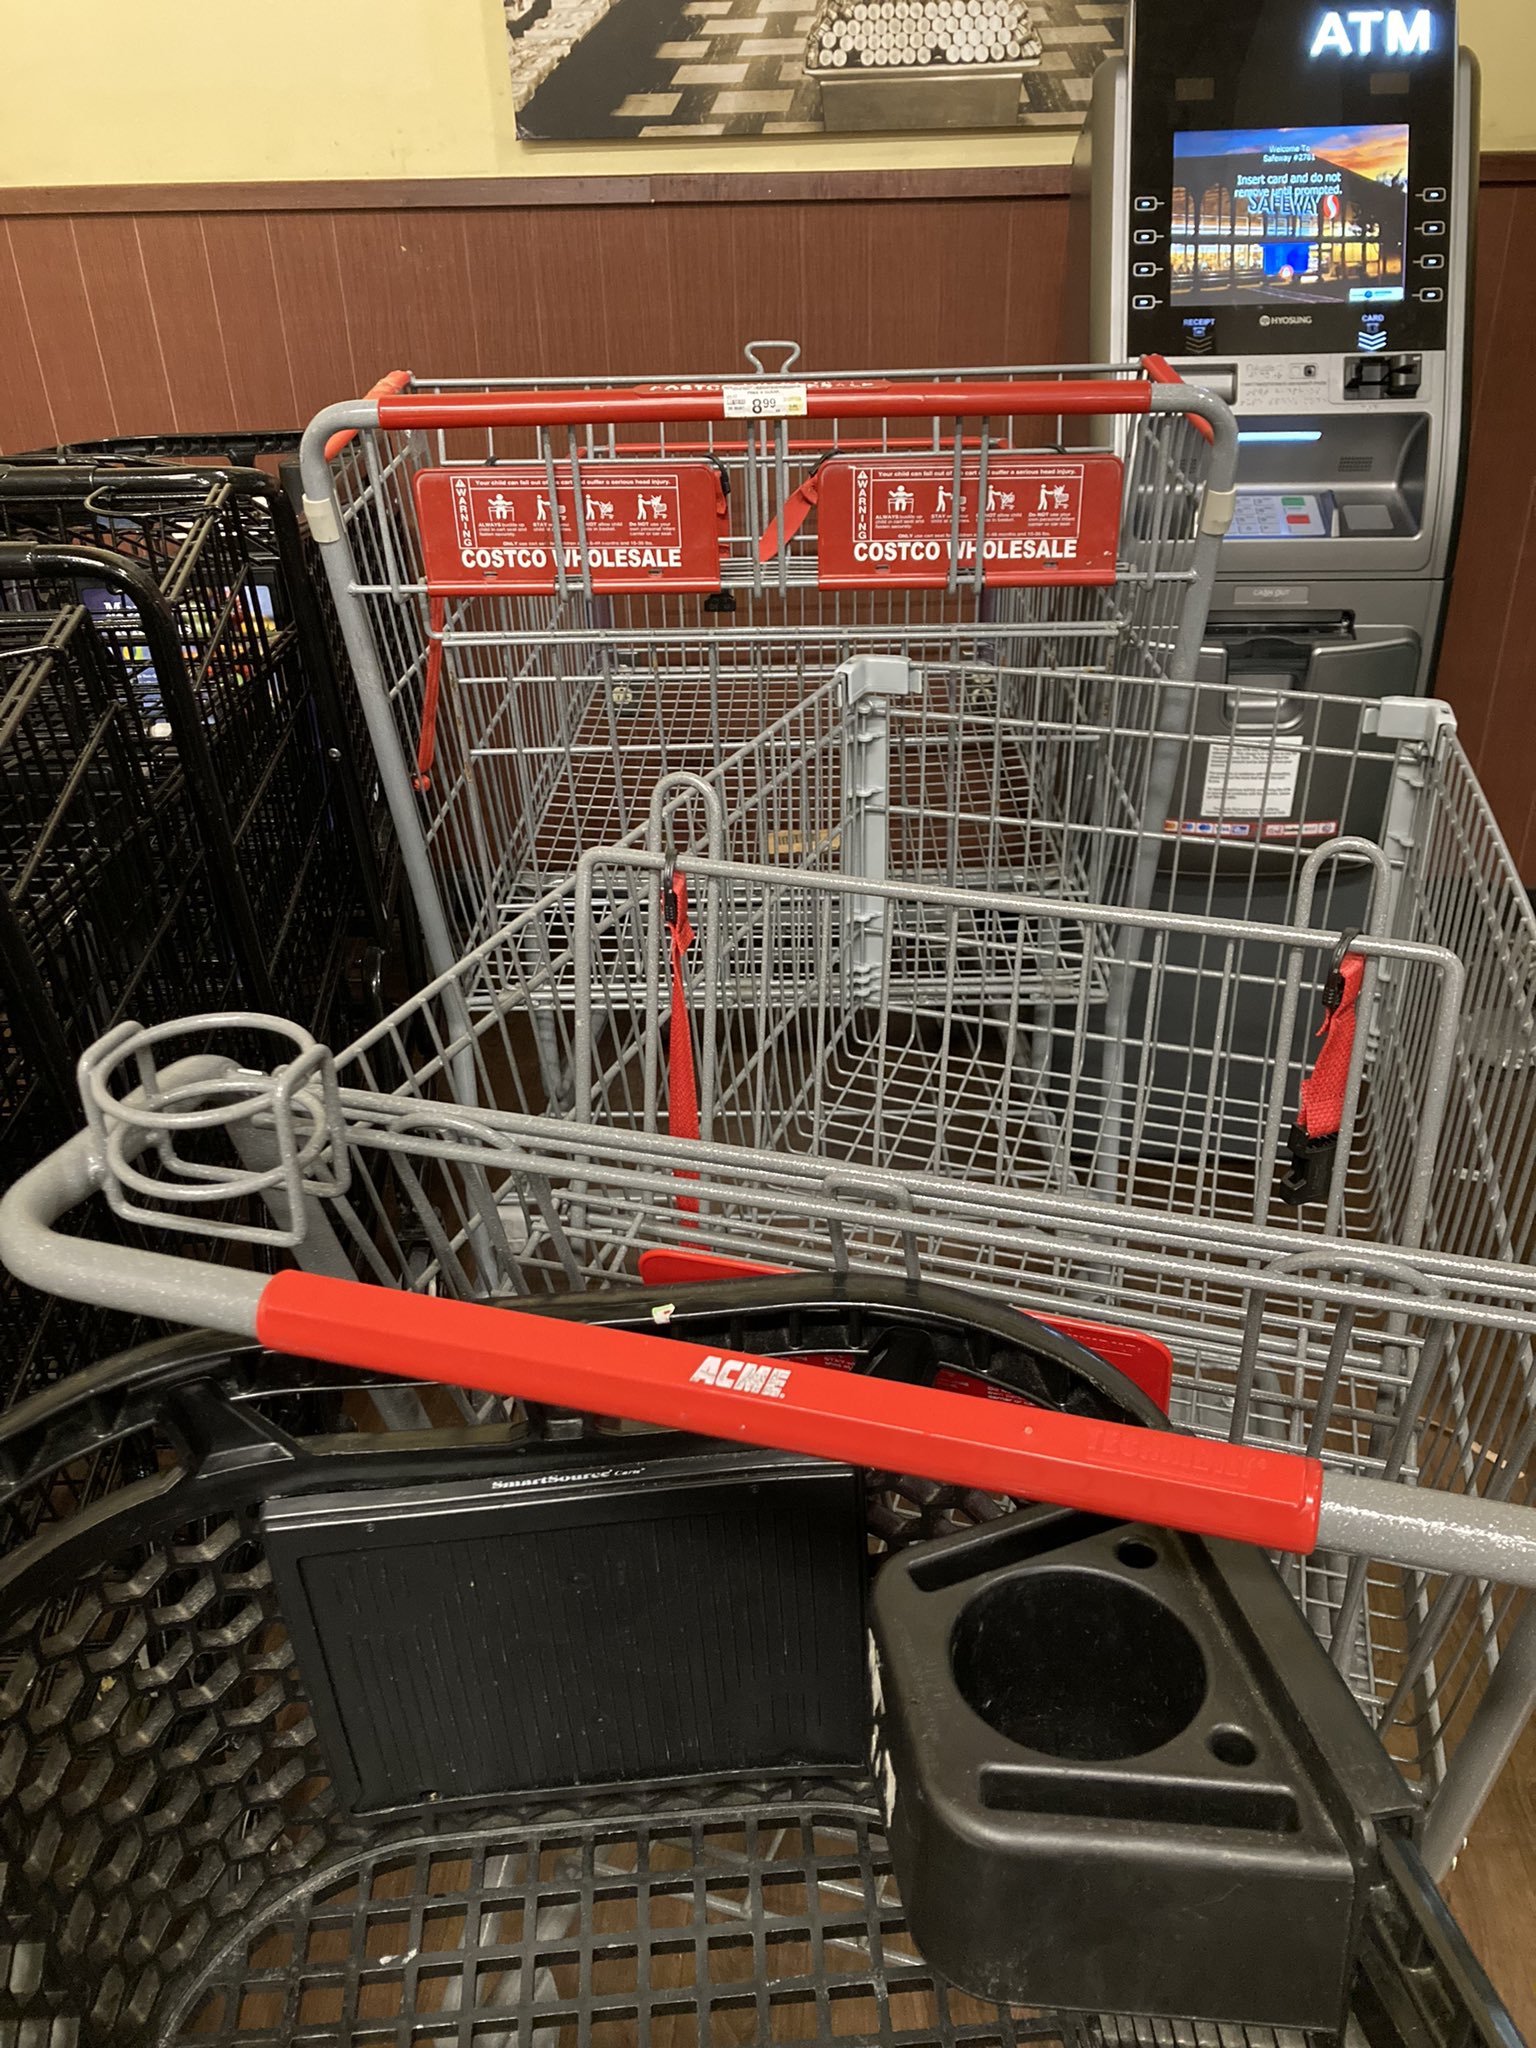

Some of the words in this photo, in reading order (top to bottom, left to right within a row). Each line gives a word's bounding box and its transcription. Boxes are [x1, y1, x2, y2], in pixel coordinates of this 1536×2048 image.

[1309, 9, 1432, 57] ATM
[1269, 145, 1300, 153] Welcome
[1301, 144, 1310, 152] To
[1263, 154, 1292, 164] Safeway
[1237, 175, 1265, 185] Insert
[1267, 173, 1288, 184] card
[1290, 172, 1308, 183] and
[1310, 172, 1323, 183] do
[1325, 172, 1342, 183] not
[1234, 188, 1269, 198] remove
[1272, 186, 1293, 196] until
[1294, 184, 1343, 197] prompted.
[1247, 194, 1321, 216] SAFEWAY
[1183, 318, 1216, 326] RECEIPT
[1271, 316, 1312, 325] HYOSUNG
[1361, 314, 1385, 322] CARD
[455, 488, 473, 547] WARNING
[857, 480, 868, 539] WARNING
[461, 549, 547, 568] COSTCO
[853, 542, 940, 562] COSTCO
[689, 1355, 792, 1398] ACME
[491, 1469, 609, 1490] SmartSource
